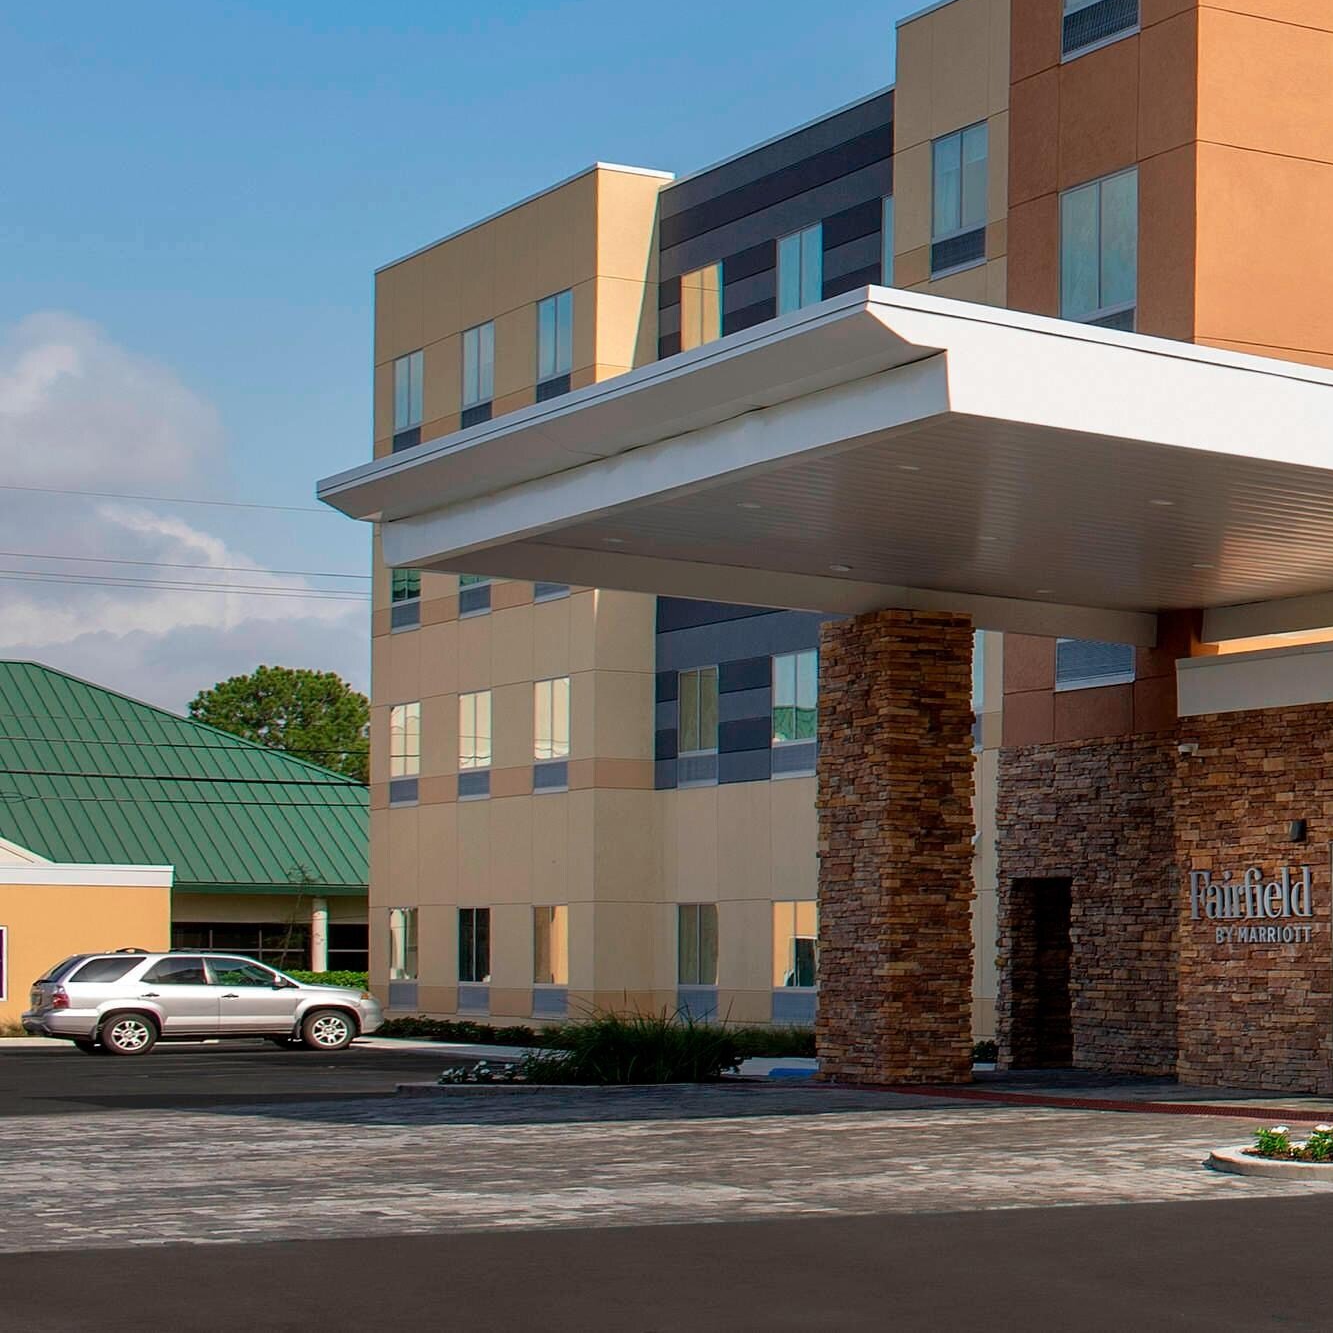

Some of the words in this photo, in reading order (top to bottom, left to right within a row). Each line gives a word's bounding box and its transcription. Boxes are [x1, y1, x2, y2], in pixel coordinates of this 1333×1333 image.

[1189, 865, 1313, 920] Fairfield
[1215, 927, 1234, 944] BY
[1238, 926, 1312, 944] MARRIOTT
